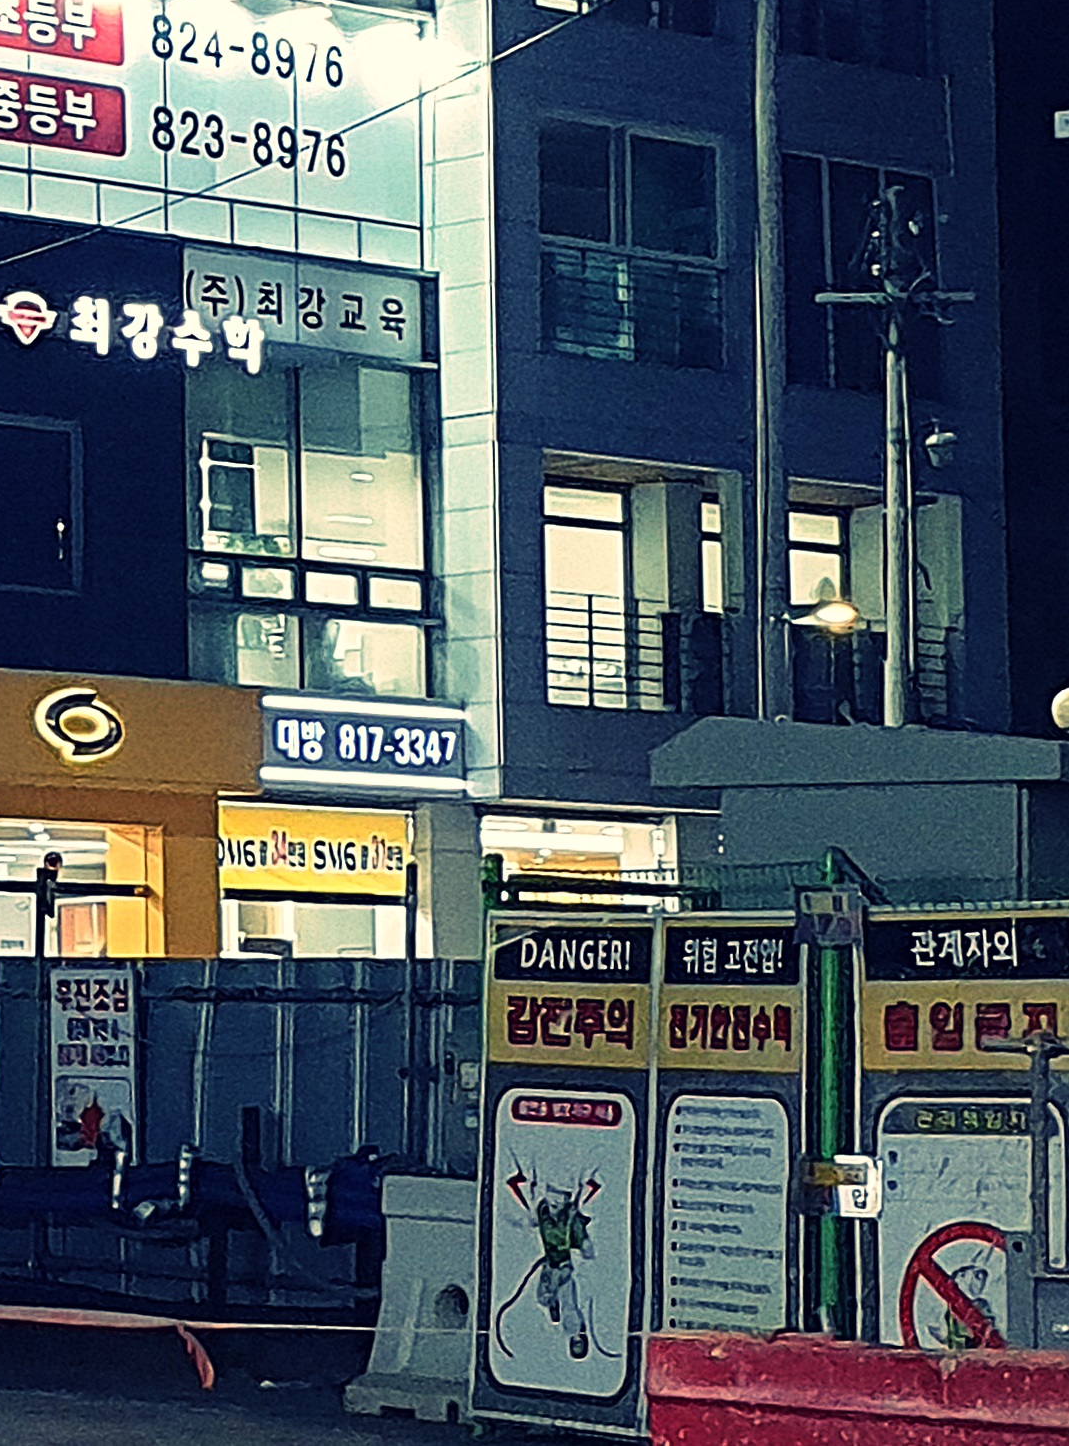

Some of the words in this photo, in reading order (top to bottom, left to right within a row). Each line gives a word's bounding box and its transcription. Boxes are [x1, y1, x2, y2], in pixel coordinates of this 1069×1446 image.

[152, 15, 344, 88] 824-8976
[152, 106, 346, 177] 823-8976
[70, 295, 265, 374] 최강수학
[276, 719, 325, 761] 대방
[339, 724, 456, 765] 817-3347
[520, 937, 631, 971] DANGER!
[683, 937, 717, 974] 위험
[911, 928, 1018, 967] 관계자외
[507, 995, 635, 1050] 감전주의
